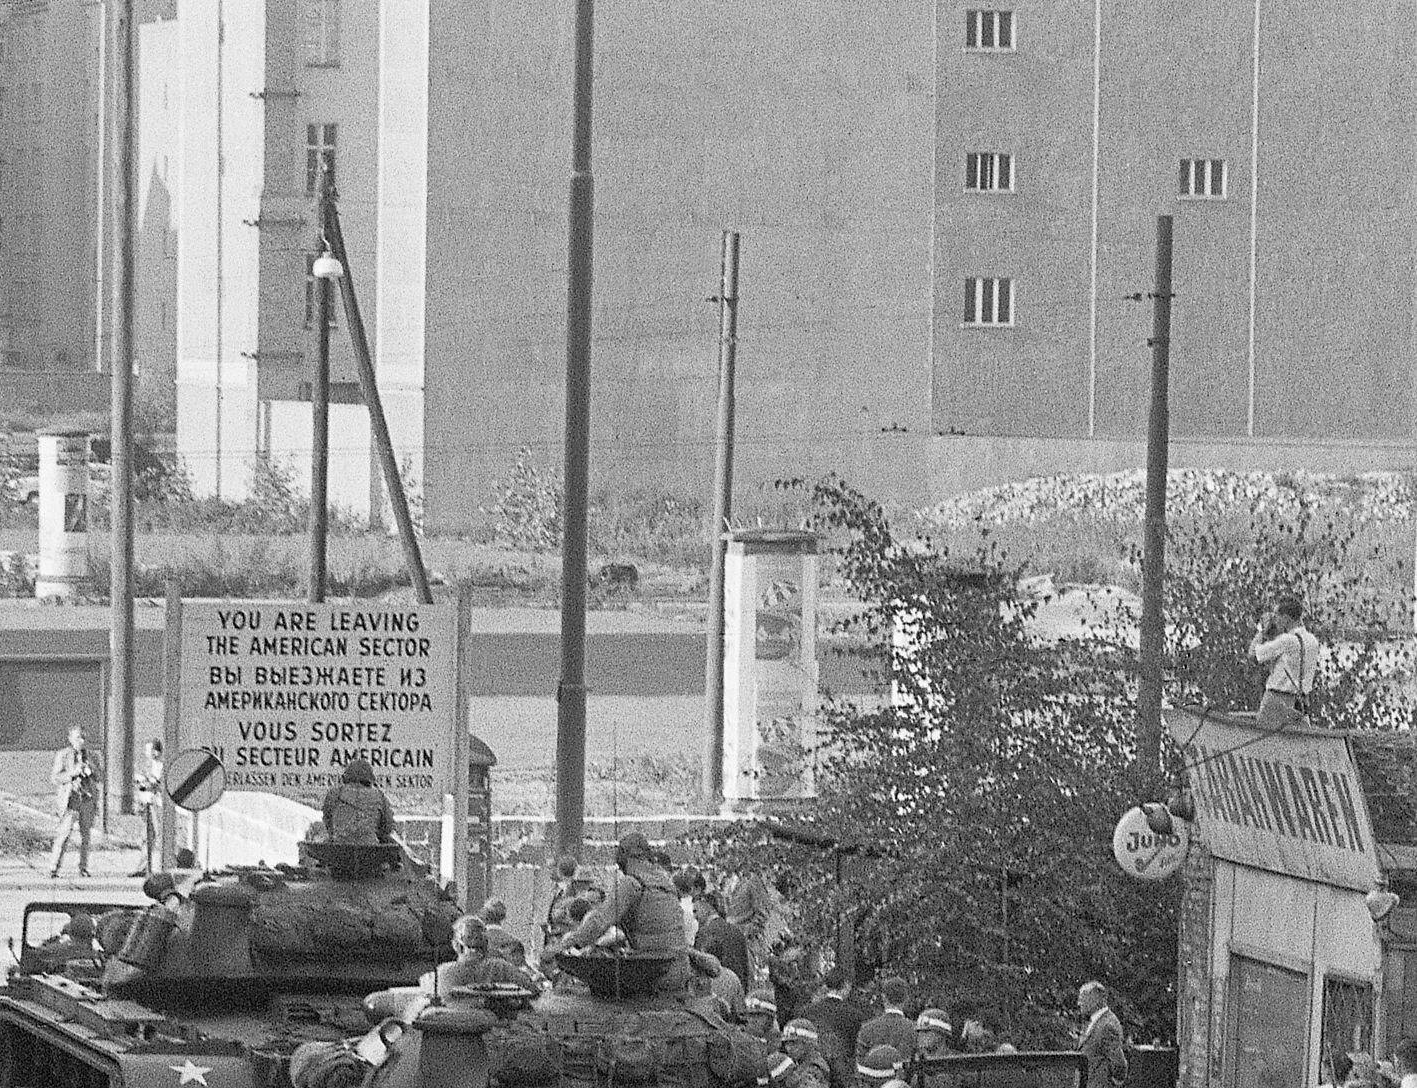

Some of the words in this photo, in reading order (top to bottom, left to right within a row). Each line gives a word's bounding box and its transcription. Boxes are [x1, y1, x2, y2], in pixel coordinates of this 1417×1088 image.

[218, 610, 261, 631] YOU
[274, 611, 317, 631] ARE
[330, 612, 419, 632] LEAVING
[206, 636, 239, 656] THE
[249, 636, 348, 656] AMERICAN
[359, 637, 431, 657] SECTOR
[209, 666, 242, 685] ВЫ
[255, 666, 385, 687] ВЫЕЗЖАЕТЕ
[400, 668, 427, 687] ИЗ
[204, 691, 349, 711] АМЕРИКАНСКОГО
[358, 692, 432, 712] СЕКТОРА
[238, 721, 297, 741] VOUS
[311, 721, 392, 743] SORTEZ
[236, 748, 320, 767] SECTEUR
[330, 748, 434, 768] AMERICAIN
